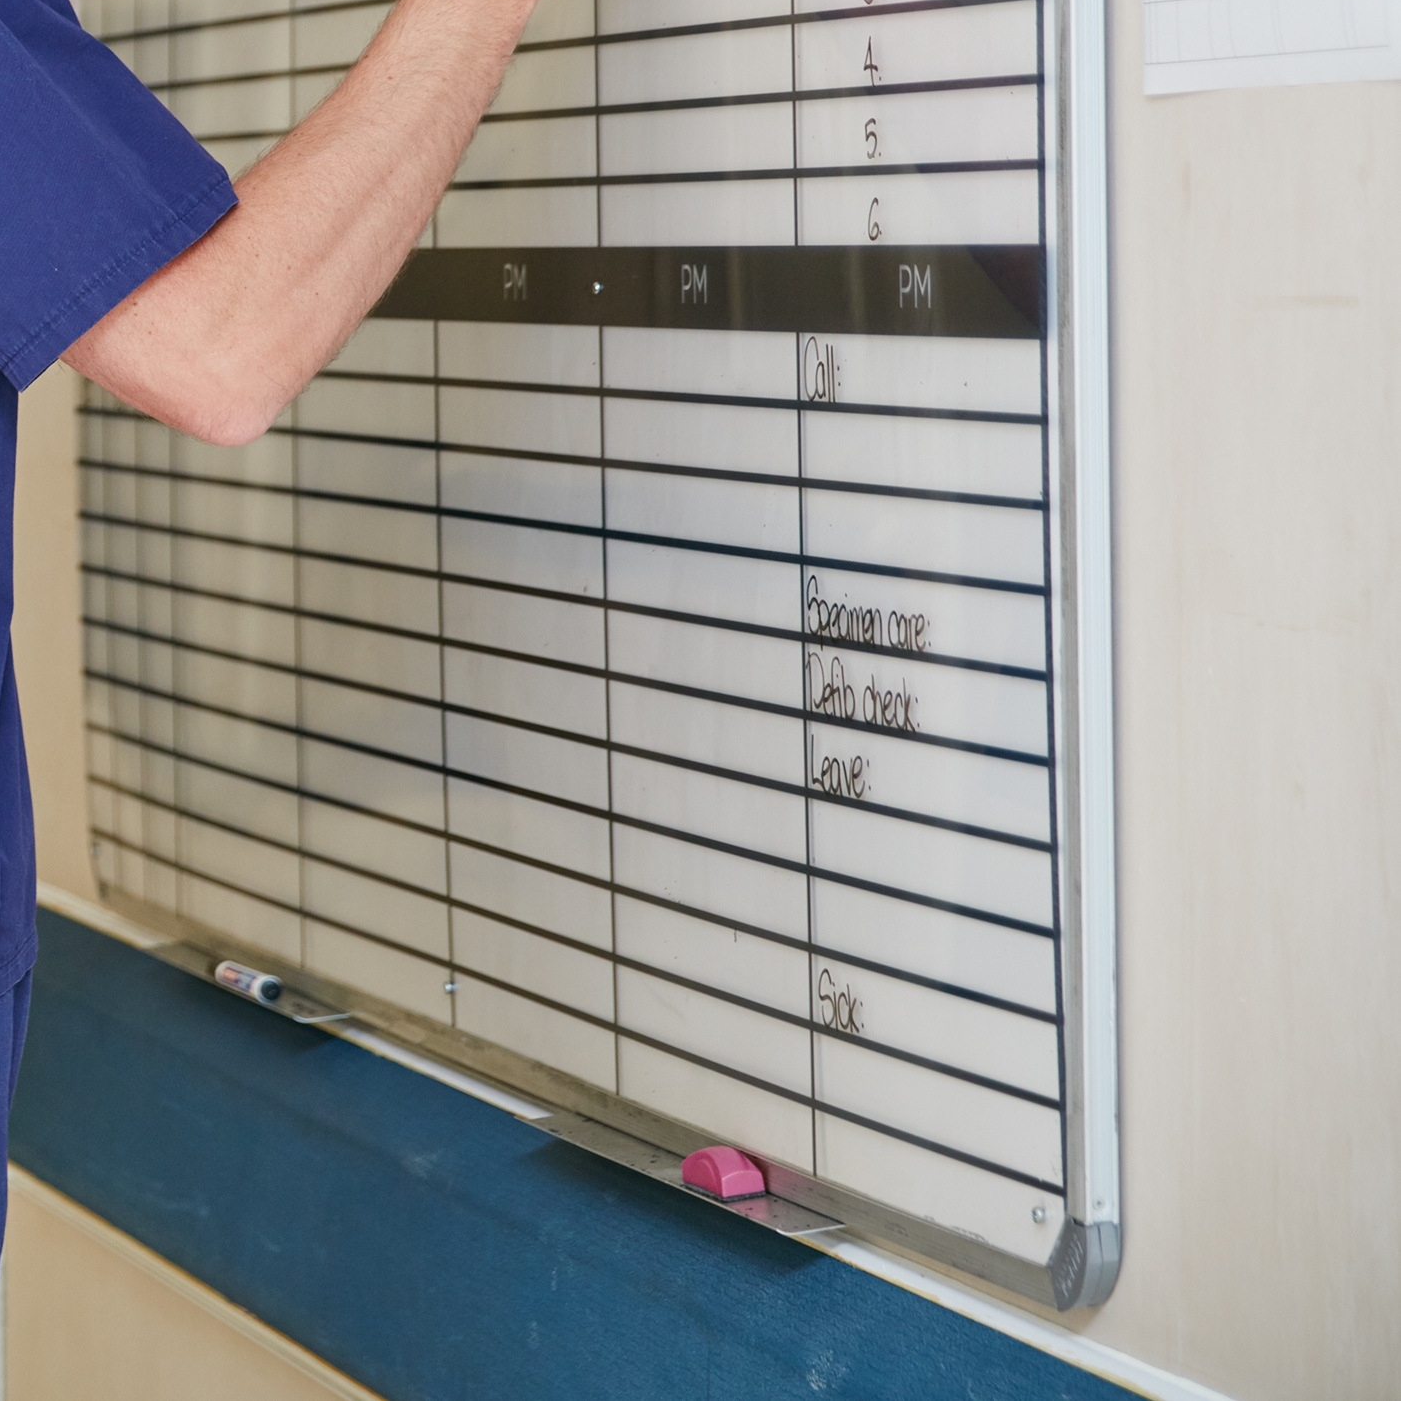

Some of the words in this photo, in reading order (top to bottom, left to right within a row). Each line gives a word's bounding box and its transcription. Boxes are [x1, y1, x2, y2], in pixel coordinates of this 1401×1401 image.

[503, 263, 528, 302] PM
[681, 263, 708, 305] PM
[899, 264, 932, 309] PM
[806, 574, 884, 651] Specimen
